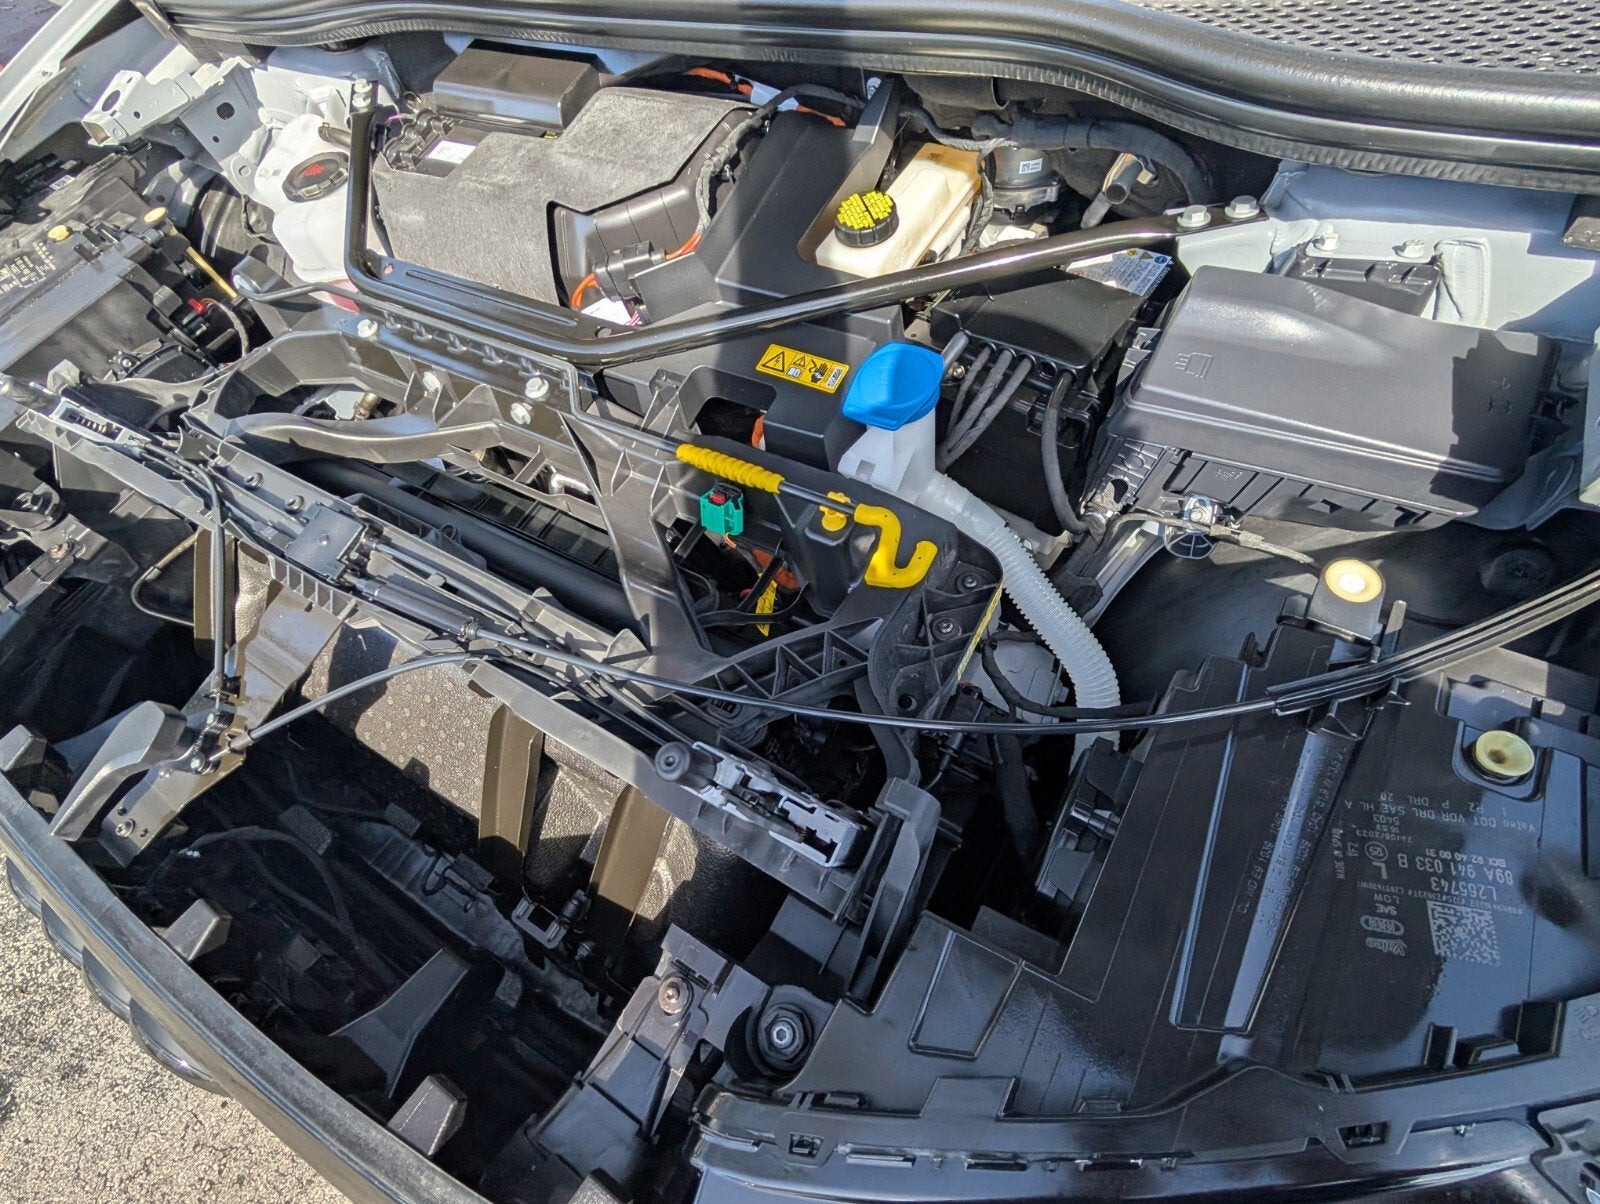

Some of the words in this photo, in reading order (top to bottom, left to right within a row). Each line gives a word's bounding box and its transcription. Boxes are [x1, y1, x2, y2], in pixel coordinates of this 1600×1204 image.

[1344, 800, 1353, 809] A
[1360, 801, 1375, 811] HL
[1406, 795, 1429, 807] DRL
[1381, 803, 1405, 816] SAE
[1412, 807, 1435, 819] DRL
[1373, 814, 1400, 826] 5403
[1441, 812, 1466, 823] VOR
[1473, 816, 1496, 828] DOT
[1333, 849, 1343, 859] IN
[1425, 848, 1437, 857] 31
[1397, 853, 1408, 869] B
[1415, 856, 1443, 874] 033
[1335, 860, 1346, 880] MADE
[1372, 861, 1388, 880] L
[1450, 861, 1477, 879] 941
[1483, 866, 1514, 885] 89A
[1430, 876, 1497, 901] L265743
[1373, 893, 1400, 905] LOW
[1375, 903, 1398, 916] SAE
